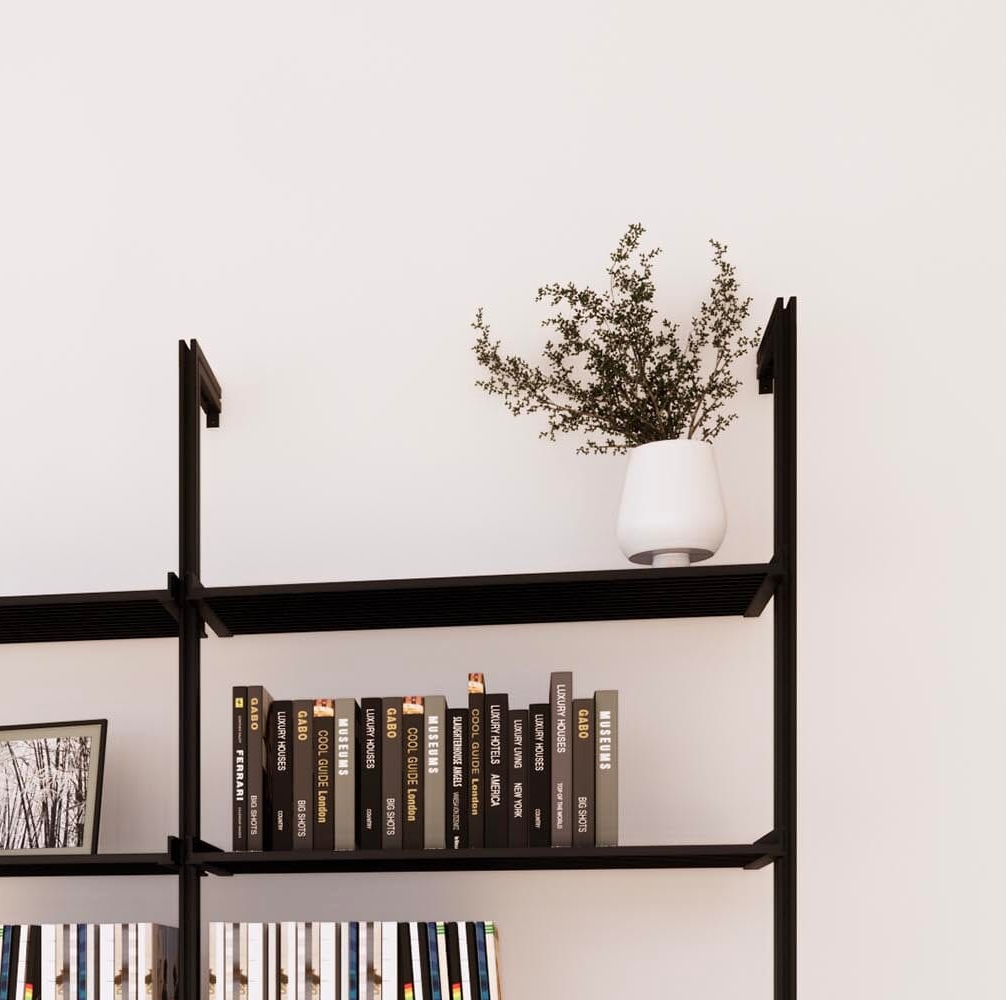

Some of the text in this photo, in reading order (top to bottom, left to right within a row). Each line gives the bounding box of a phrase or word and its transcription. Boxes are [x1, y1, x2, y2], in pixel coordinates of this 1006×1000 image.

[277, 712, 286, 771] LUXURY HOUSES
[297, 711, 307, 741] GABO
[366, 709, 375, 768] LUXURY HOUSES
[386, 708, 396, 738] GABO
[452, 716, 462, 765] SLAUGHTERHOUSE
[490, 705, 500, 765] LUXURY HOTELS
[514, 720, 522, 768] LUXURY LIVING
[534, 714, 544, 771] LUXURY HOUSES
[557, 685, 566, 753] LUXURY HOUSES
[578, 709, 589, 739] GABO
[599, 711, 611, 770] MUSEUMS
[338, 718, 349, 776] MUSEUMS
[428, 716, 438, 774] MUSEUMS
[471, 709, 480, 816] COOL GUIDE London
[236, 750, 244, 801] FERRARI
[318, 730, 328, 823] COOL GUIDE London
[407, 728, 418, 821] COOL GUIDE London
[452, 766, 462, 787] ANGELS
[490, 774, 500, 807] AMERICA
[297, 800, 306, 837] BIG SHOTS
[386, 798, 395, 835] BIG SHOTS
[514, 783, 522, 818] NEW YORK
[578, 797, 587, 832] BIG SHOTS
